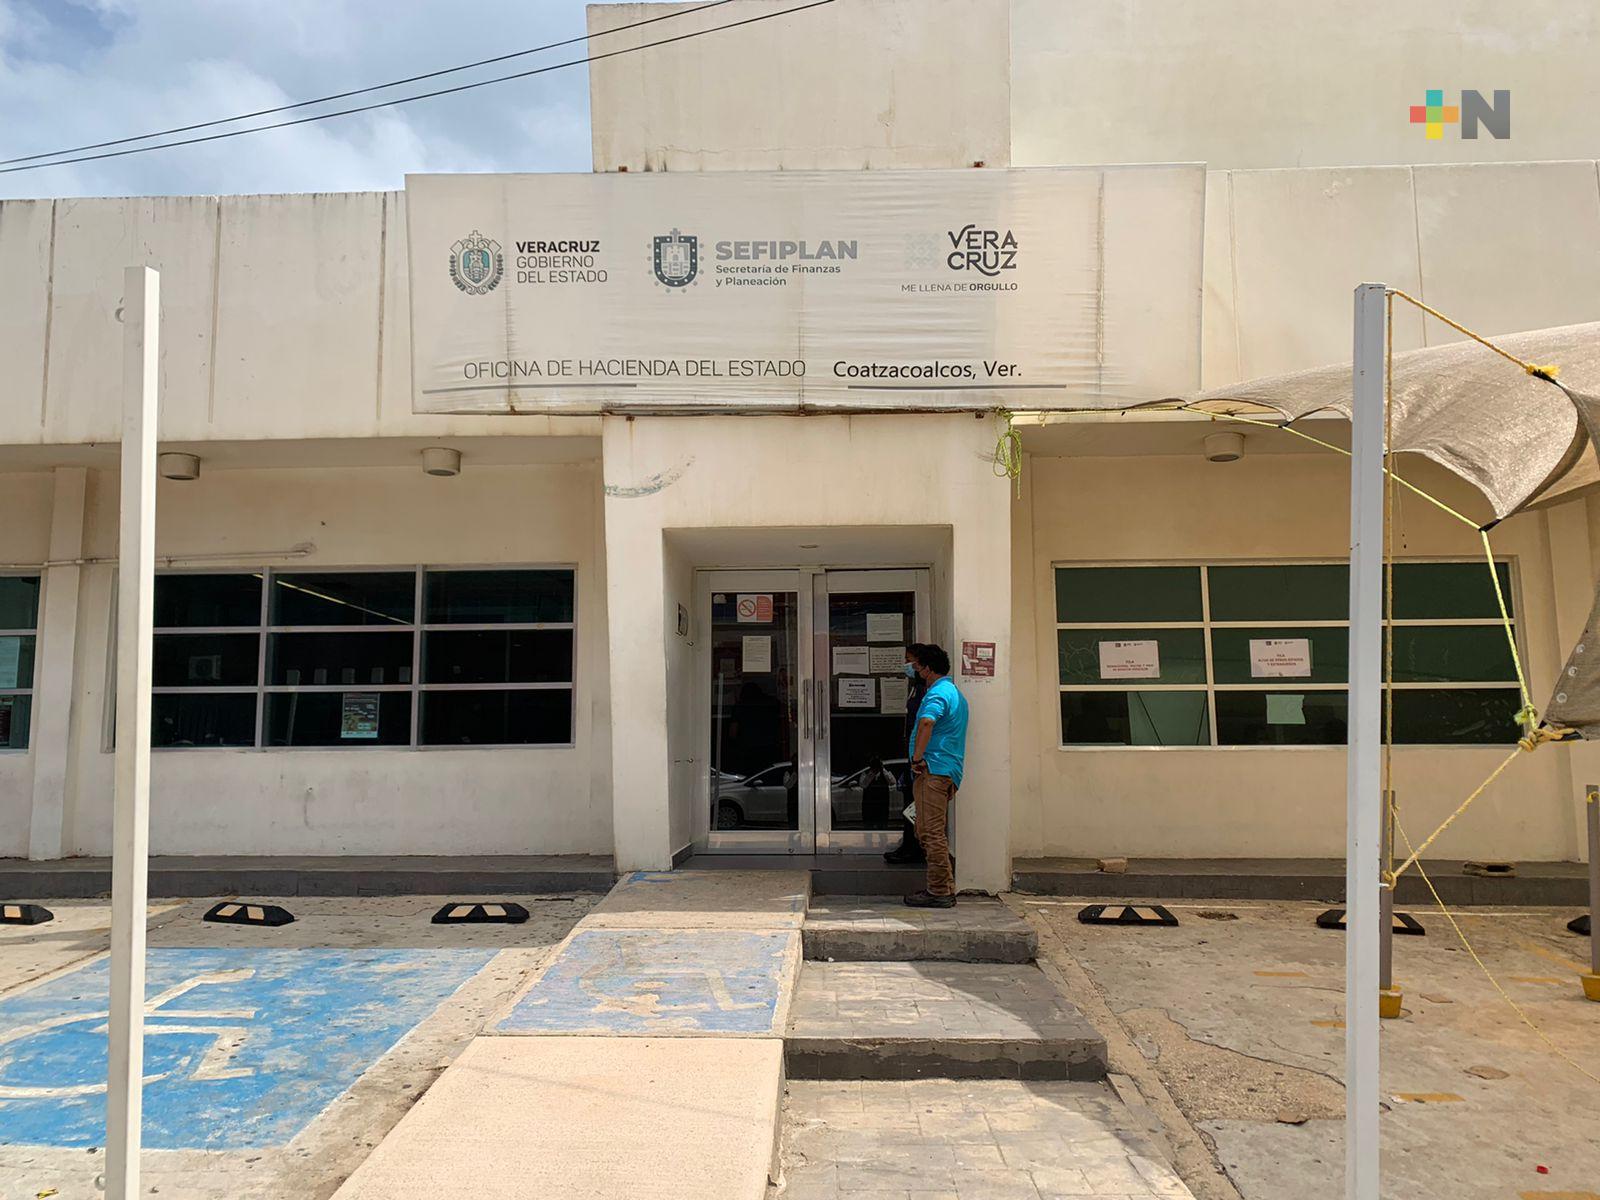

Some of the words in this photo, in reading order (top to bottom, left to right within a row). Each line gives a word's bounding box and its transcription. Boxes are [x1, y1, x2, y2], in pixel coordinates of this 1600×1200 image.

[947, 223, 1018, 249] VERA
[516, 240, 600, 253] VERACRUZ
[715, 240, 858, 260] SEFIPLAN
[516, 254, 594, 268] GOBIERNO
[946, 250, 1018, 277] CRUZ
[715, 264, 772, 273] Secretaría
[774, 264, 789, 273] de
[791, 264, 841, 273] Finanzas
[517, 270, 546, 283] DEL
[549, 270, 608, 283] ESTADO
[715, 278, 722, 287] y
[725, 277, 787, 286] Planeación
[901, 284, 916, 292] ME
[919, 284, 952, 292] LLENA
[953, 283, 967, 291] DE
[969, 282, 1018, 291] ORGULLO
[464, 360, 543, 380] OFICINA
[547, 359, 573, 376] DE
[579, 359, 681, 376] HACIENDA
[685, 359, 723, 377] DEL
[728, 359, 806, 377] ESTADO
[833, 361, 977, 380] Coatzacoalcos,
[983, 360, 1022, 377] Ver.
